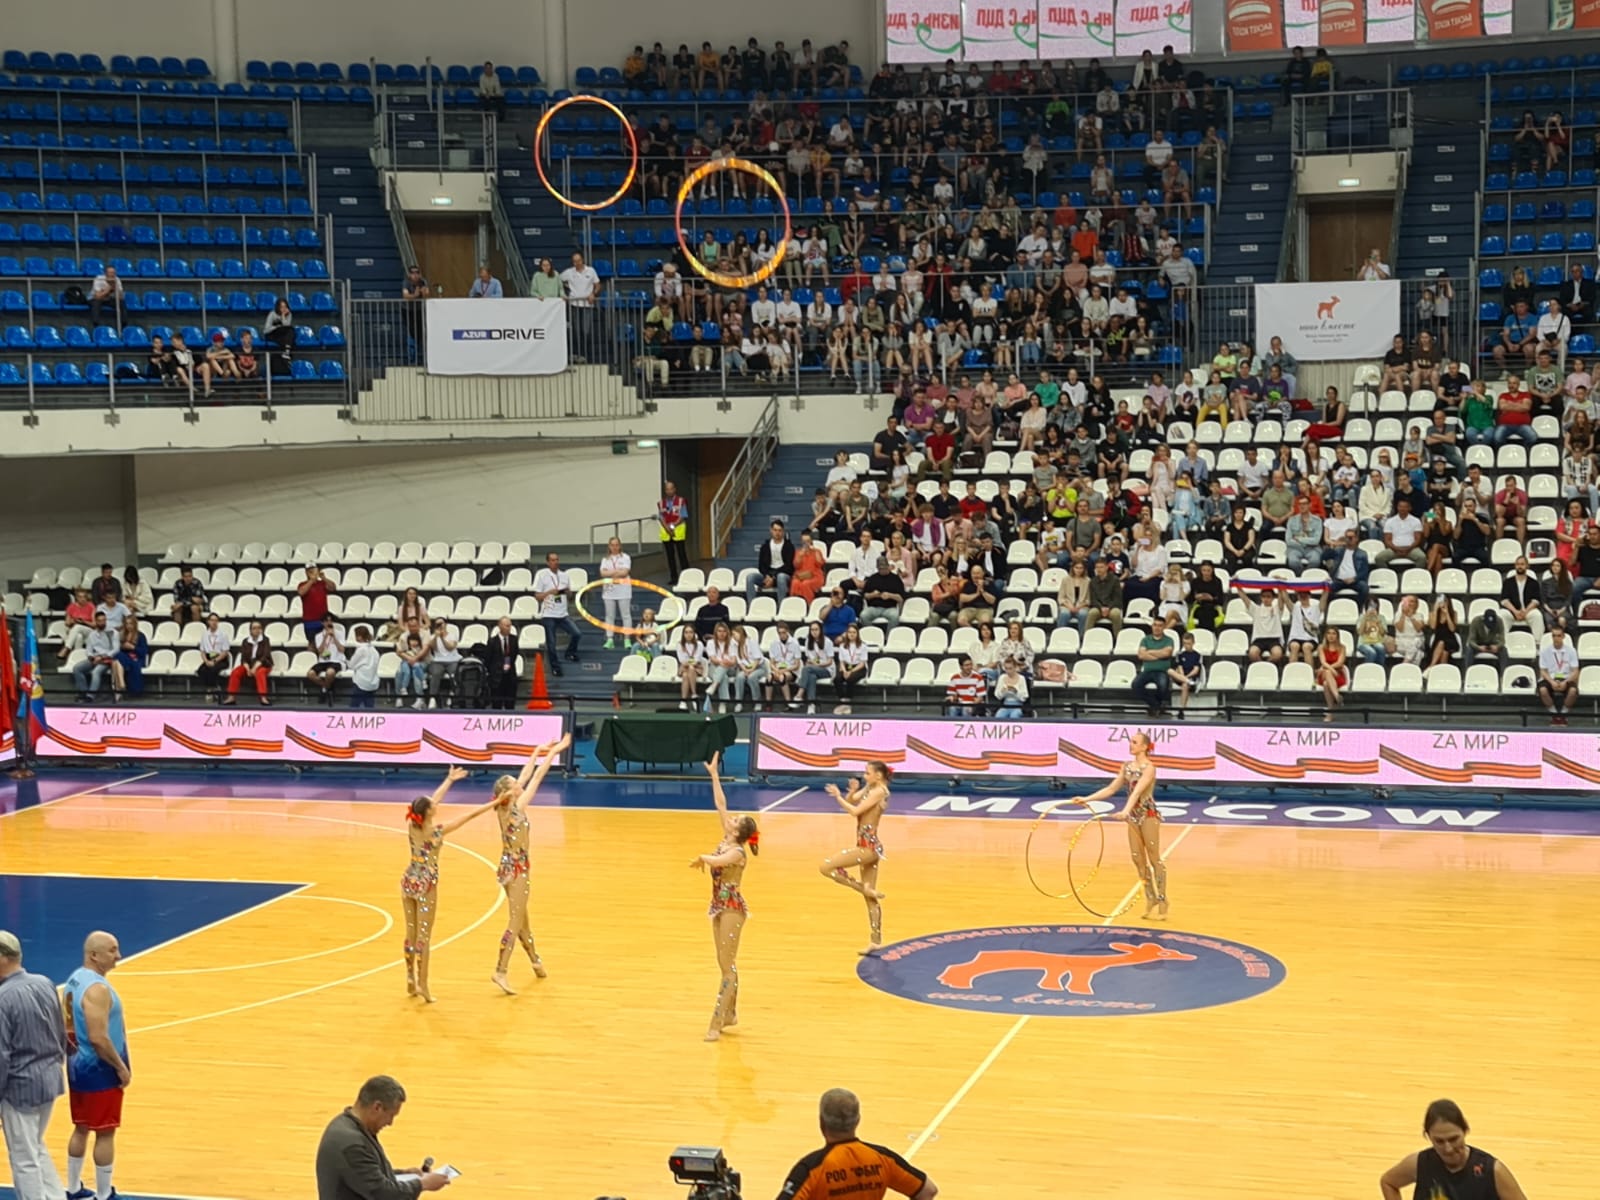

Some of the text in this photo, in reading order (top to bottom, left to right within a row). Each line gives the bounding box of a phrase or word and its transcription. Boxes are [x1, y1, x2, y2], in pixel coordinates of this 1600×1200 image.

[489, 329, 545, 340] DRIVE
[103, 712, 137, 726] МИР
[228, 714, 262, 728] МИР
[351, 716, 386, 730] МИР
[488, 718, 524, 732] МИР
[833, 721, 872, 737] МИР
[982, 724, 1023, 740] МИР
[1297, 731, 1340, 747] МИР
[1464, 734, 1509, 750] МИР
[914, 795, 1504, 828] MOSCOW
